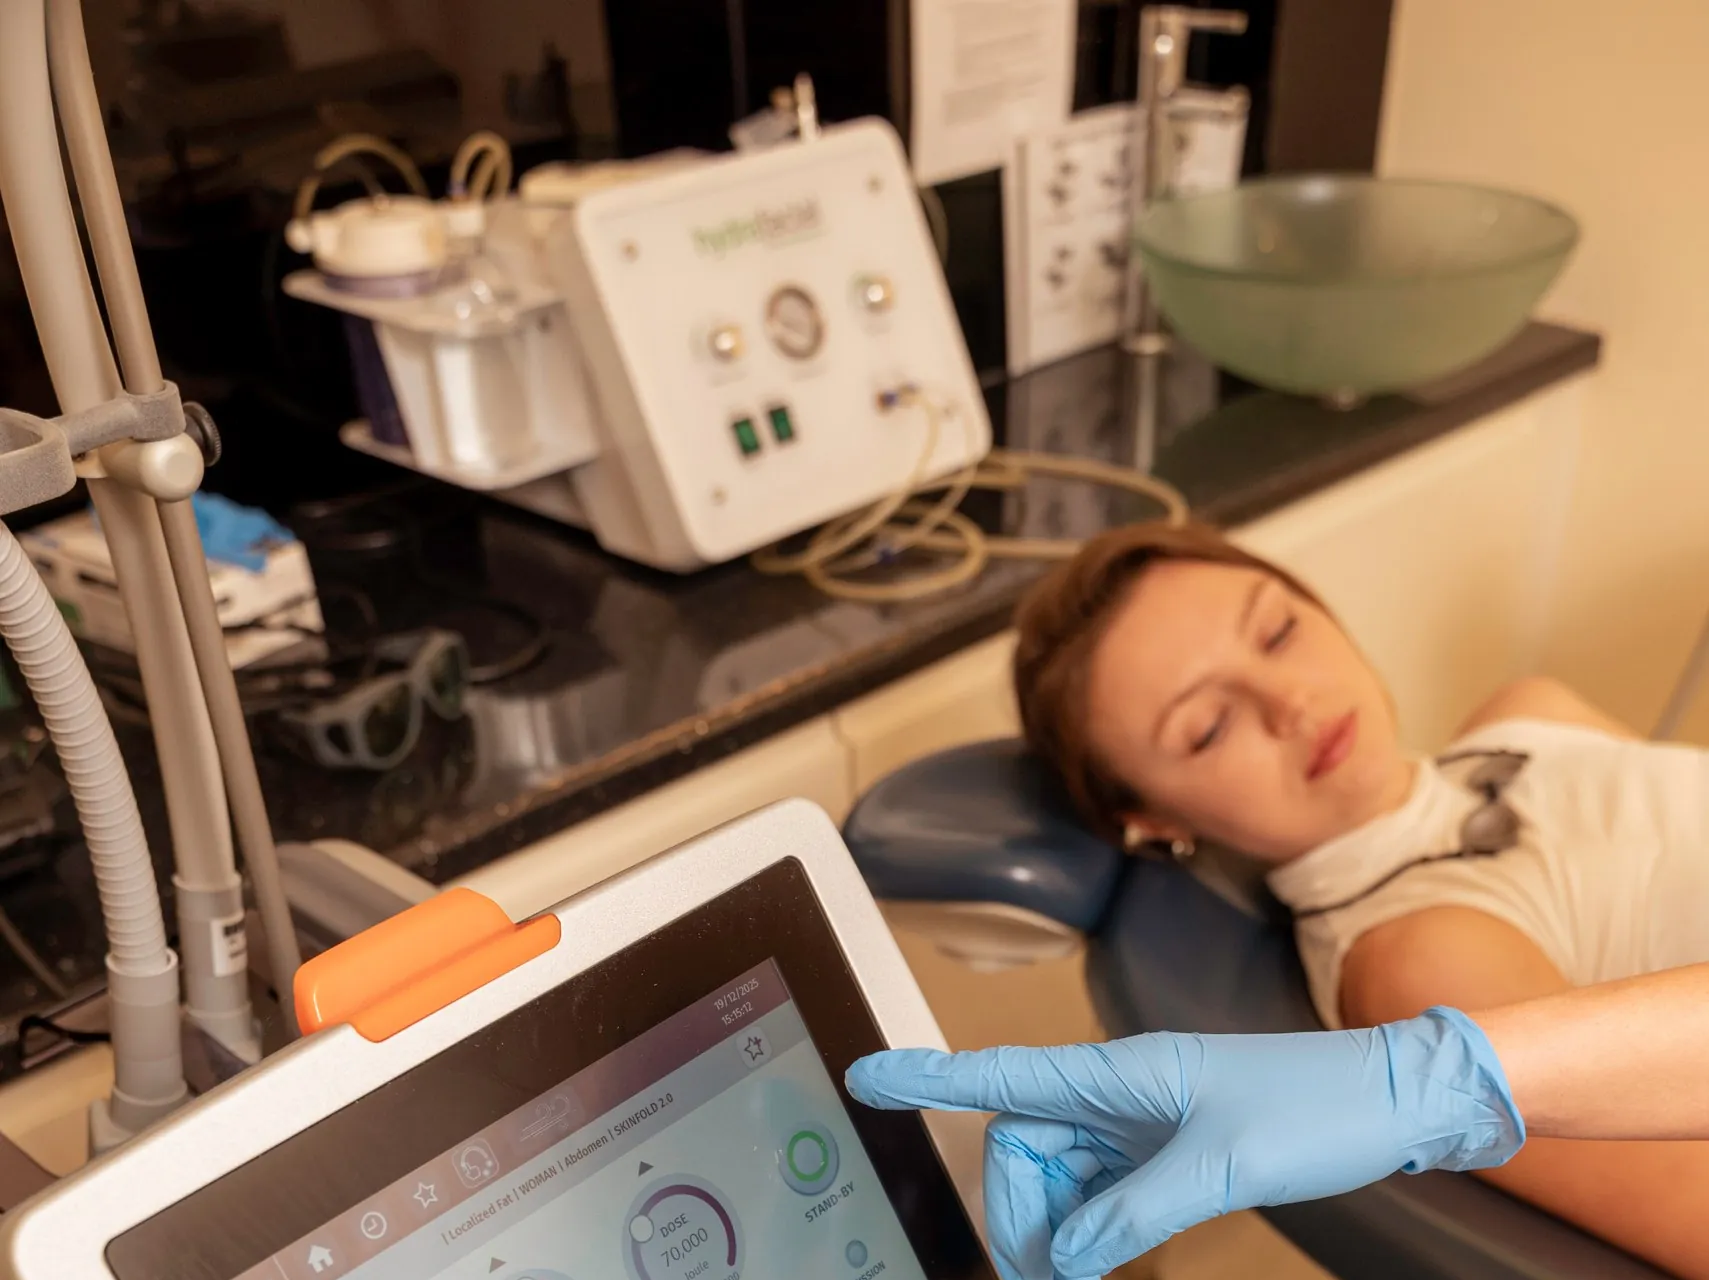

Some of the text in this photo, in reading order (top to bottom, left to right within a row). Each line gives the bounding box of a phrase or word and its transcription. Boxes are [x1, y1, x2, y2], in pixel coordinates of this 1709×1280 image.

[714, 978, 759, 1010] 19/12/2025
[721, 1001, 753, 1026] 15:15:12
[448, 1203, 497, 1240] Localized
[497, 1194, 514, 1210] Fat
[518, 1166, 558, 1196] WOMAN
[564, 1135, 609, 1168] Abdomen
[613, 1102, 659, 1136] SKINFOLD
[657, 1093, 674, 1109] 2.0
[804, 1181, 855, 1223] STAND-BY
[659, 1213, 689, 1238] DOSE
[660, 1227, 708, 1267] 70,000
